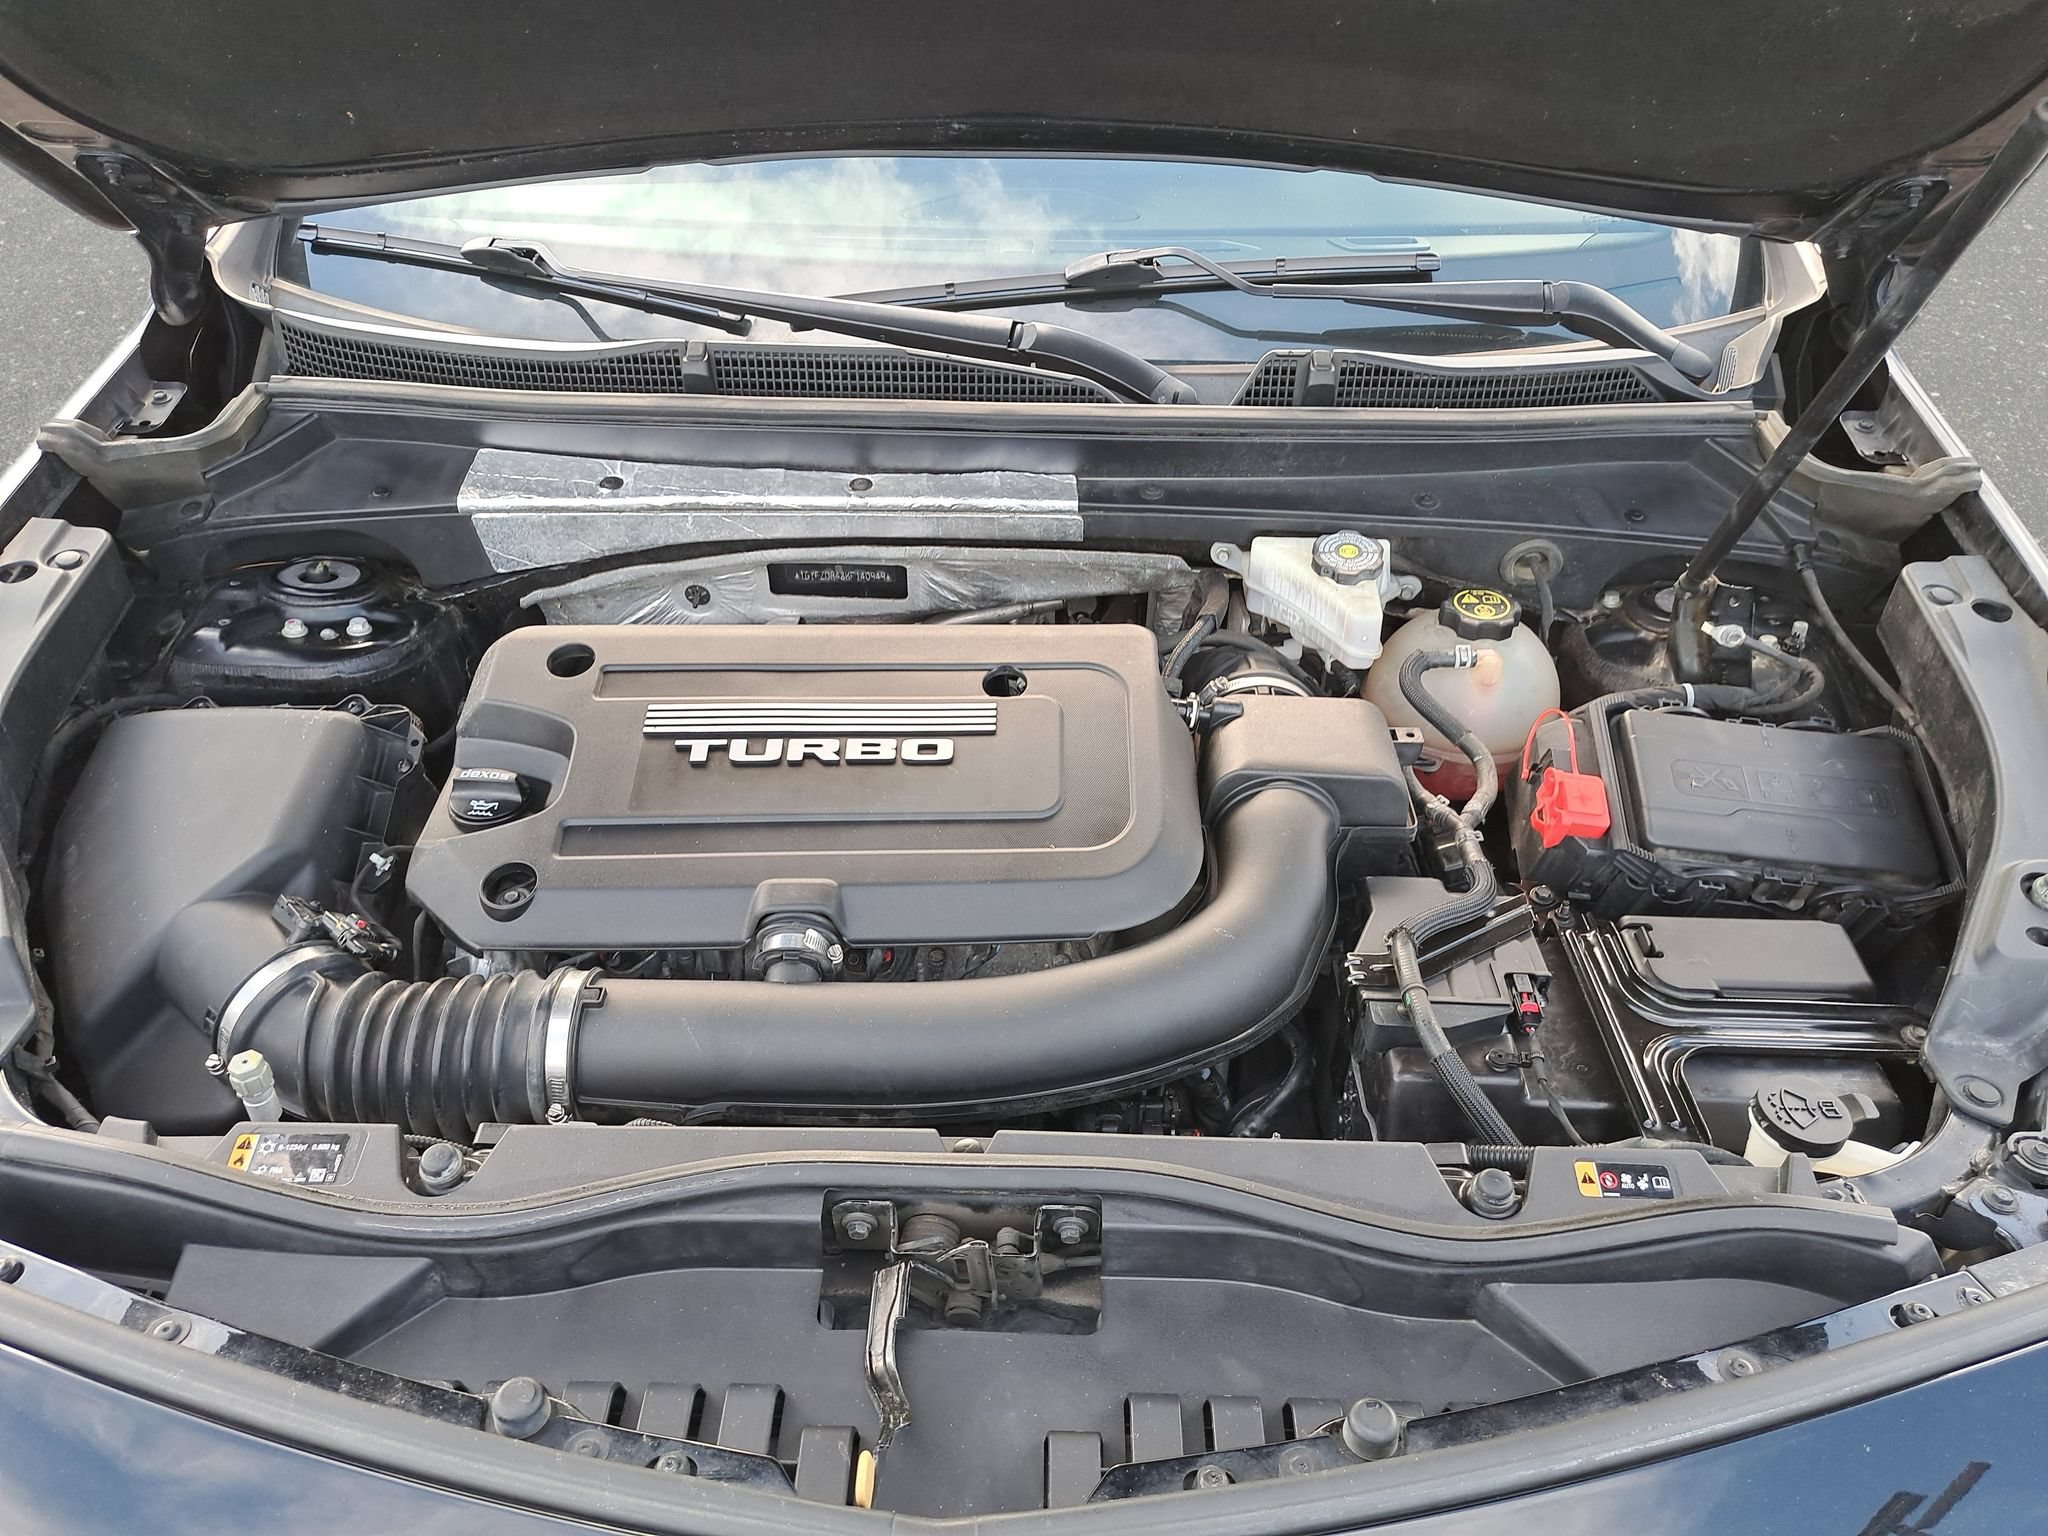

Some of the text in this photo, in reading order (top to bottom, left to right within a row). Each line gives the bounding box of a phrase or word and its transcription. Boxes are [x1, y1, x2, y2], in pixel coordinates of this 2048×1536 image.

[673, 738, 954, 766] TURBO
[459, 768, 510, 780] dexos
[331, 1143, 341, 1151] kg
